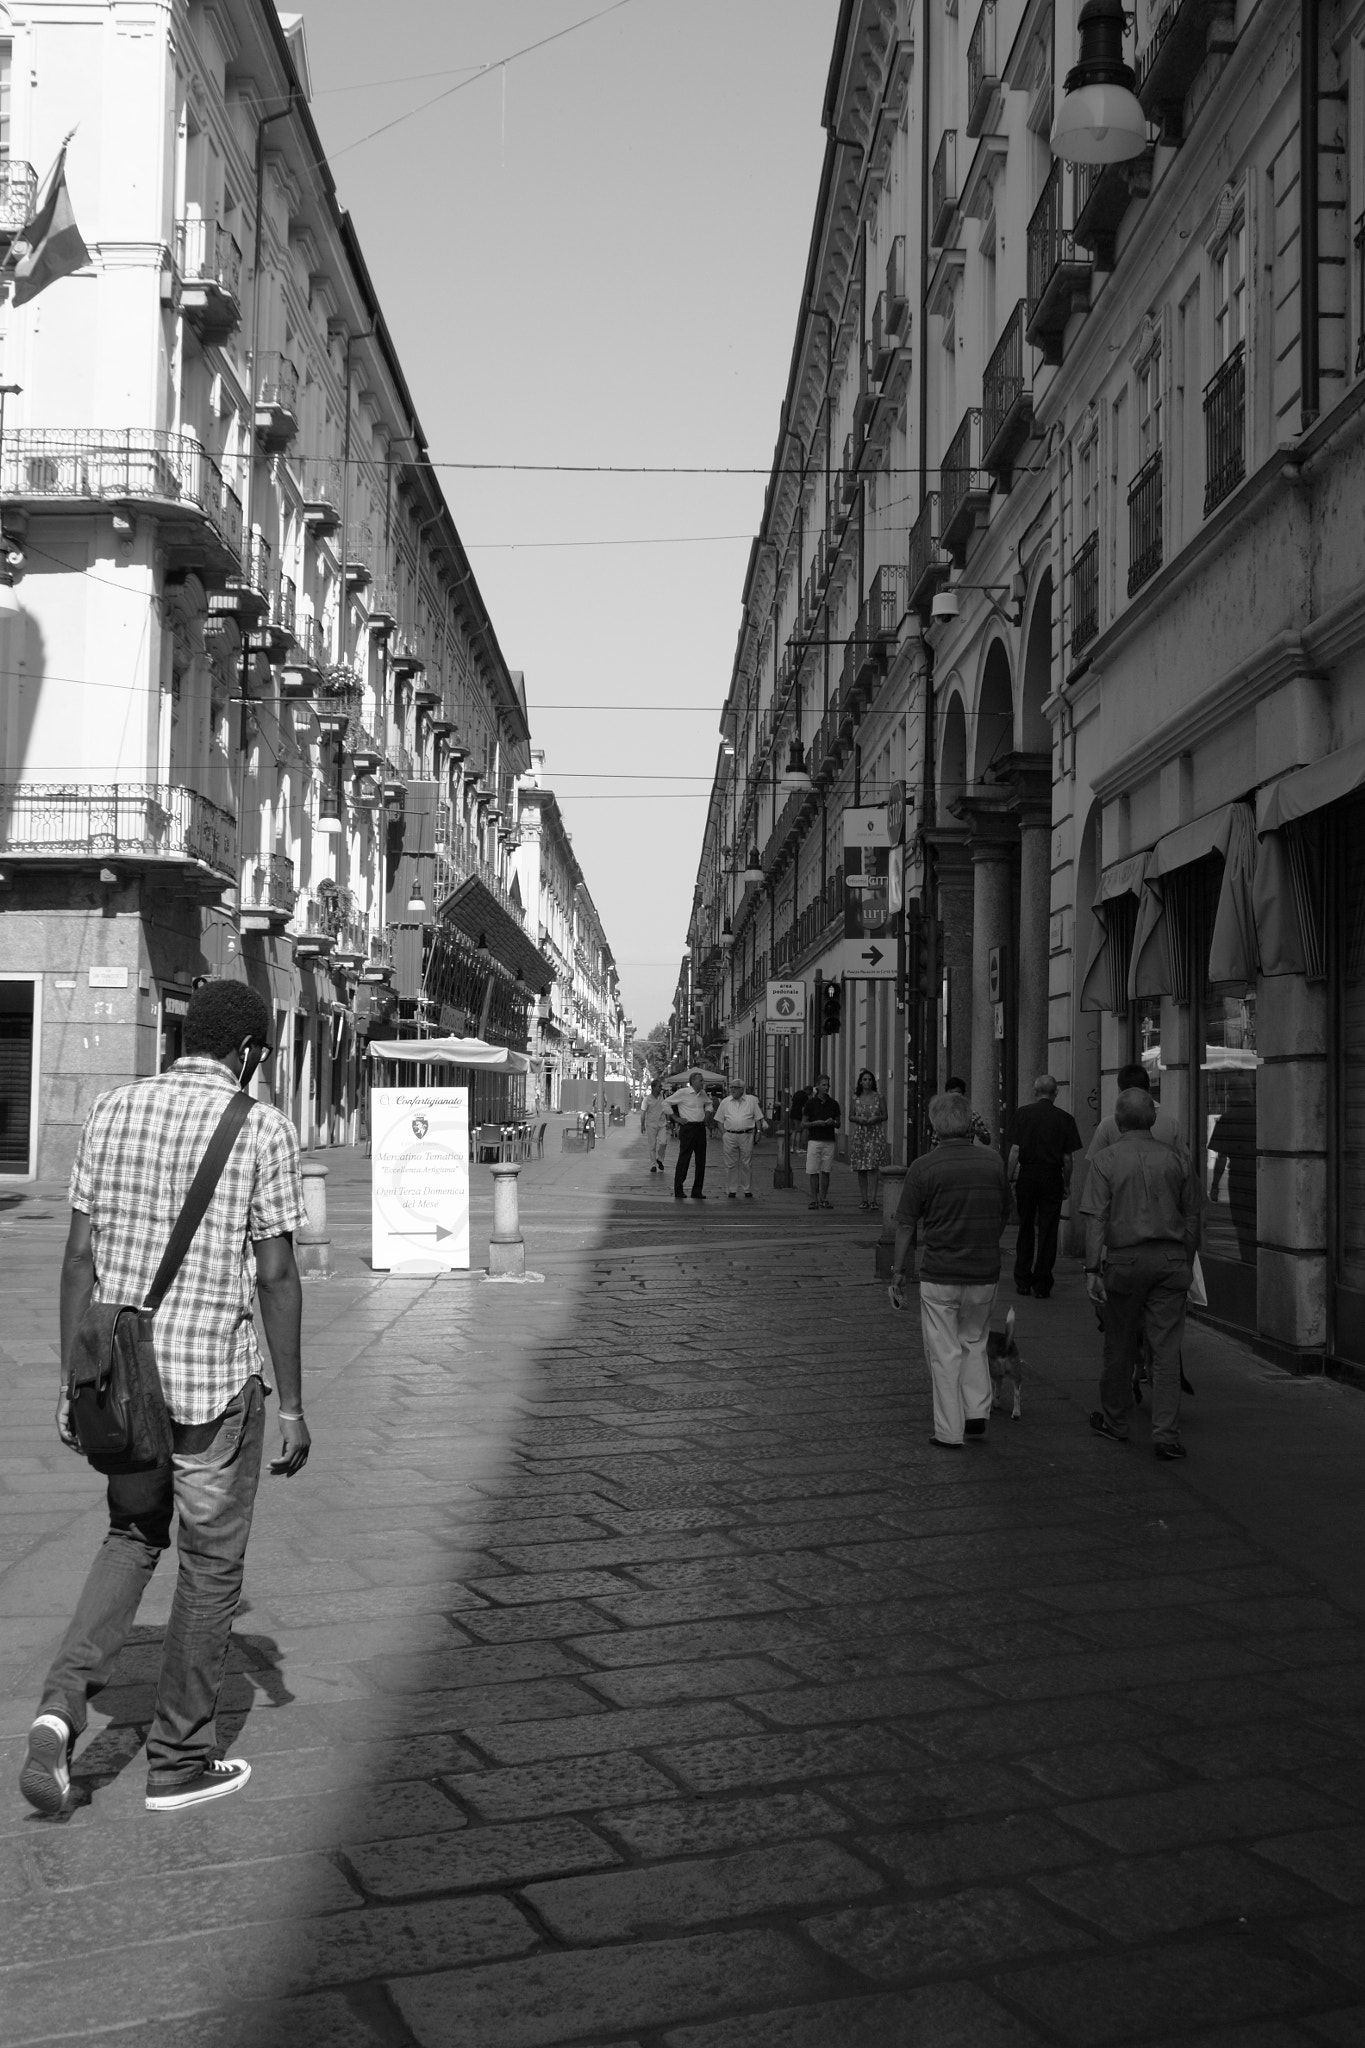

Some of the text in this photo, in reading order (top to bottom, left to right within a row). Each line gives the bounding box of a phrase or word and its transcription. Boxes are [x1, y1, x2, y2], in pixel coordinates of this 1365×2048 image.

[889, 801, 903, 827] STOP
[396, 1095, 463, 1107] Confartigianato
[378, 1152, 464, 1161] Mercatino Tematico
[376, 1186, 465, 1196] Ogni Terza Domenica
[402, 1199, 439, 1208] del Mese
